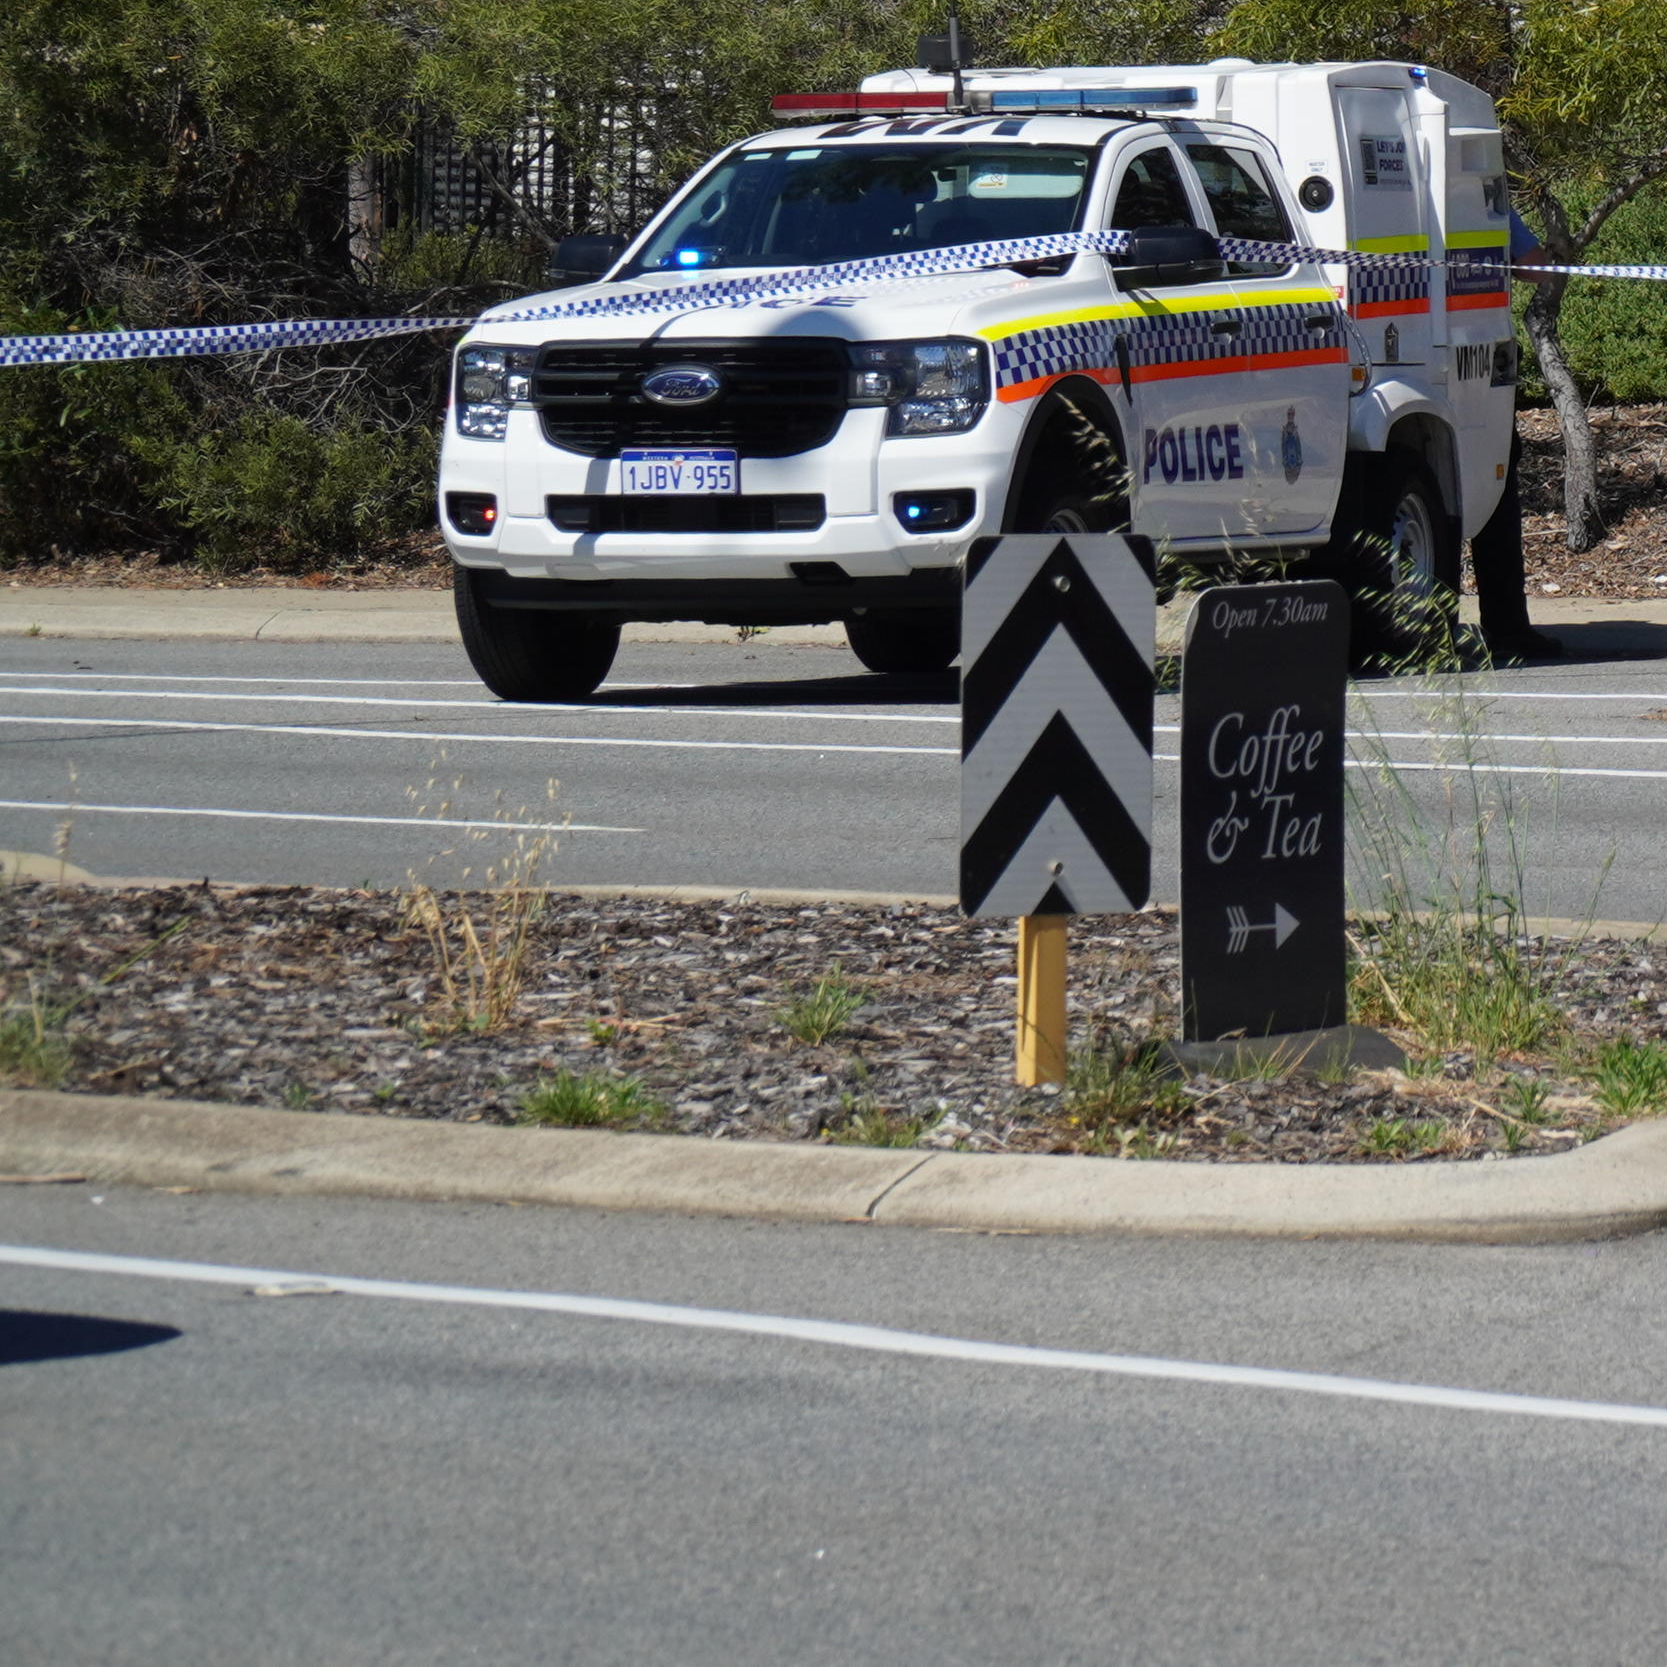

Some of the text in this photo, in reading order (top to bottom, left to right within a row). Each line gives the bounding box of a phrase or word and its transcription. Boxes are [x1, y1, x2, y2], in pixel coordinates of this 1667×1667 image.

[660, 377, 702, 395] Ford
[1456, 344, 1490, 382] VM104
[1144, 423, 1244, 485] POLICE
[1212, 596, 1329, 639] Open 7.30am
[1208, 704, 1325, 798] Coffee
[1206, 790, 1323, 864] & Tea
